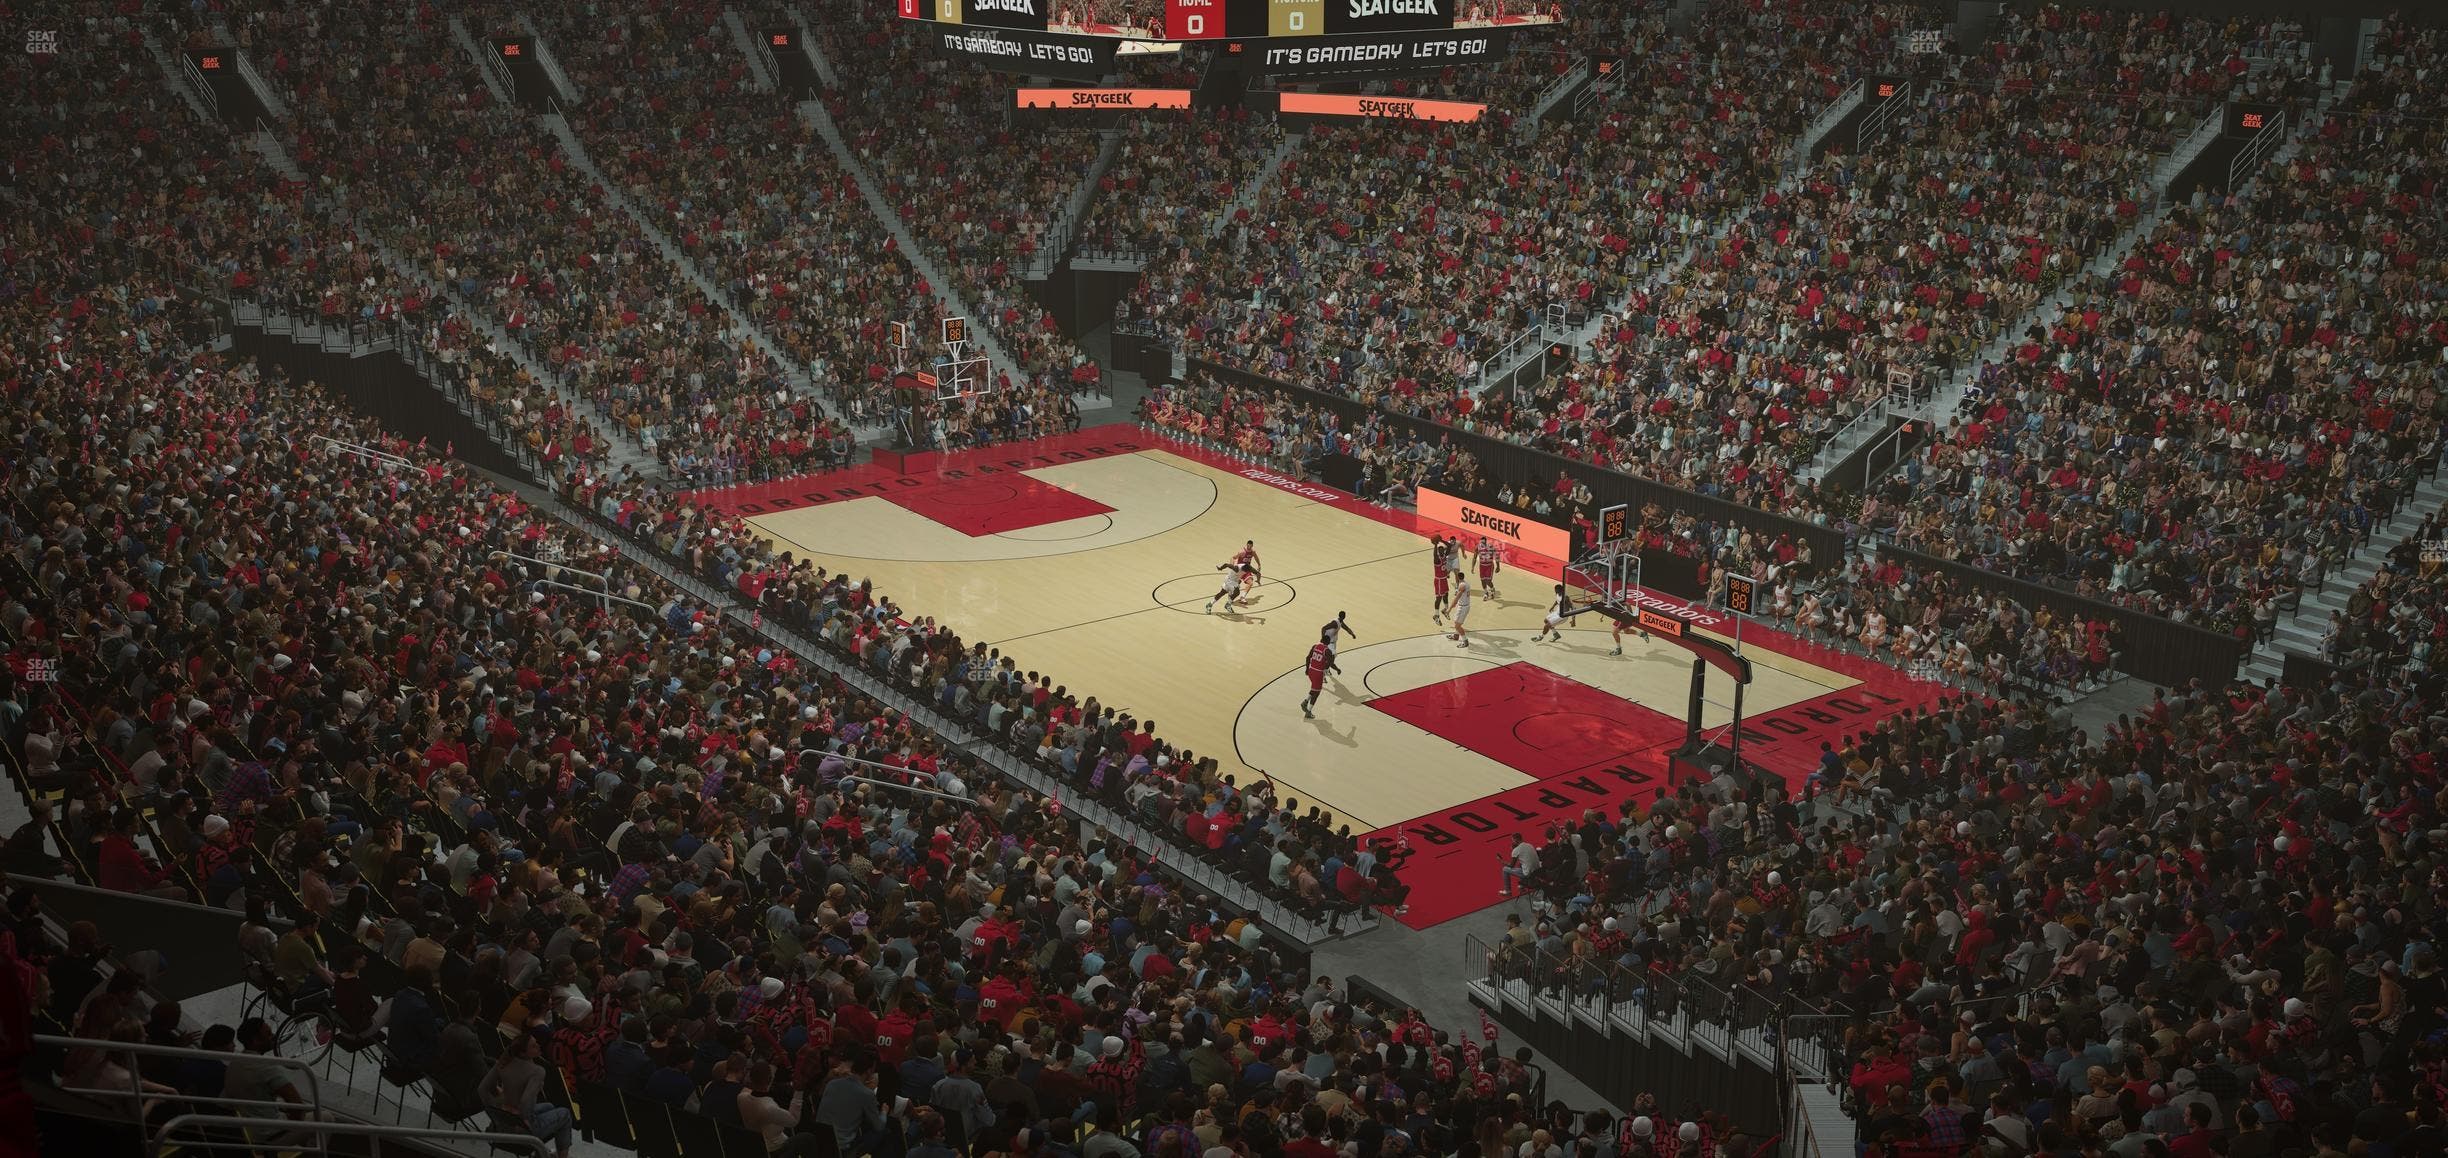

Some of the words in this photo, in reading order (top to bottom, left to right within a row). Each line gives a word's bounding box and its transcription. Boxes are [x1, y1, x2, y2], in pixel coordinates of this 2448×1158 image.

[944, 0, 952, 18] 0
[1349, 0, 1439, 19] SEATGEEK
[1187, 14, 1204, 35] 0
[1289, 11, 1304, 31] 0
[944, 34, 963, 50] IT'S
[963, 37, 1022, 57] GAMEDAY
[1029, 44, 1065, 61] LET'S
[1067, 47, 1095, 63] GO!
[1266, 48, 1302, 65] IT'S
[1306, 43, 1403, 64] GAMEDAY
[1412, 41, 1458, 58] LET'S
[1460, 39, 1487, 55] GO!
[1072, 92, 1132, 105] SEATGEEK
[1358, 100, 1415, 117] SEATGEEK
[1240, 469, 1340, 501] raptors.com
[1461, 506, 1521, 541] SEATGEEK
[1607, 521, 1623, 538] 88
[1615, 589, 1720, 625] @raptors
[1732, 592, 1747, 611] 88
[1643, 611, 1676, 633] SEATGEEK
[974, 936, 986, 947] 00
[982, 998, 997, 1009] 00
[877, 1035, 893, 1047] 00
[1253, 1035, 1267, 1046] 00
